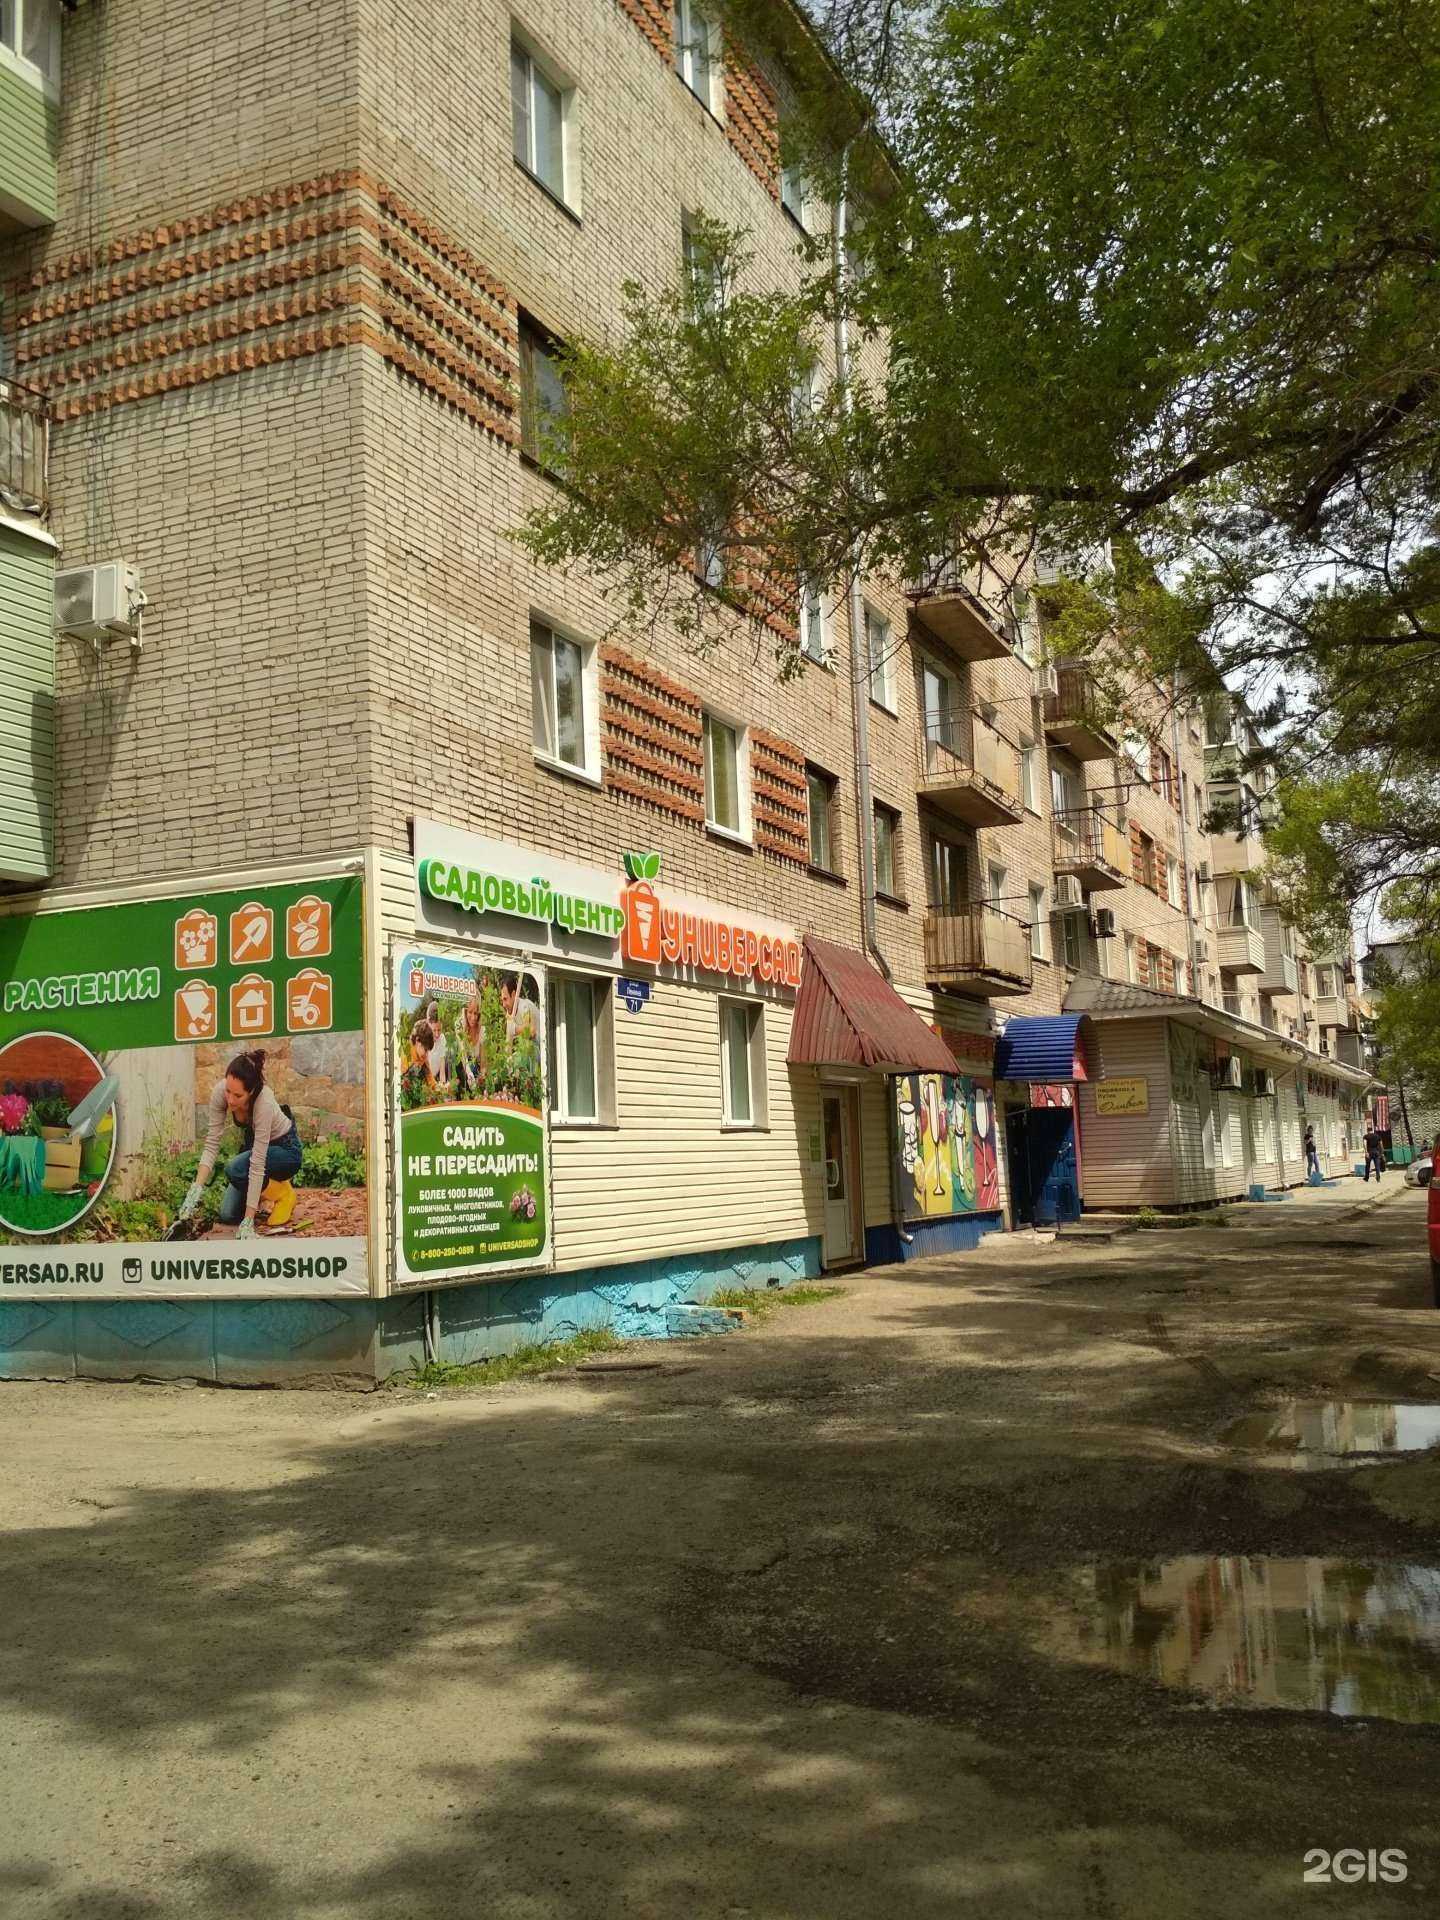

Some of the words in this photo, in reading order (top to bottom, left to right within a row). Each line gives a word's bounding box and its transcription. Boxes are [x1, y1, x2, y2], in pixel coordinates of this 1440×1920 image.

[426, 863, 553, 922] САДОВЫЙ
[556, 893, 624, 936] ЦЕНТР
[661, 907, 802, 986] УНИВЕРСАД
[4, 967, 160, 1012] РАСТЕНИЯ
[425, 973, 476, 996] УНИВЕРСАД
[630, 999, 638, 1011] 71
[443, 1126, 504, 1149] САДИТЬ
[408, 1155, 431, 1176] НЕ
[435, 1153, 538, 1177] ПЕРЕСАДИТЬ!
[419, 1189, 446, 1201] БОЛЕЕ
[447, 1188, 466, 1200] 1000
[468, 1187, 494, 1199] ВИДОВ
[0, 1262, 104, 1284] ERSAD.RU
[150, 1256, 348, 1281] UNIVERSADSHOP
